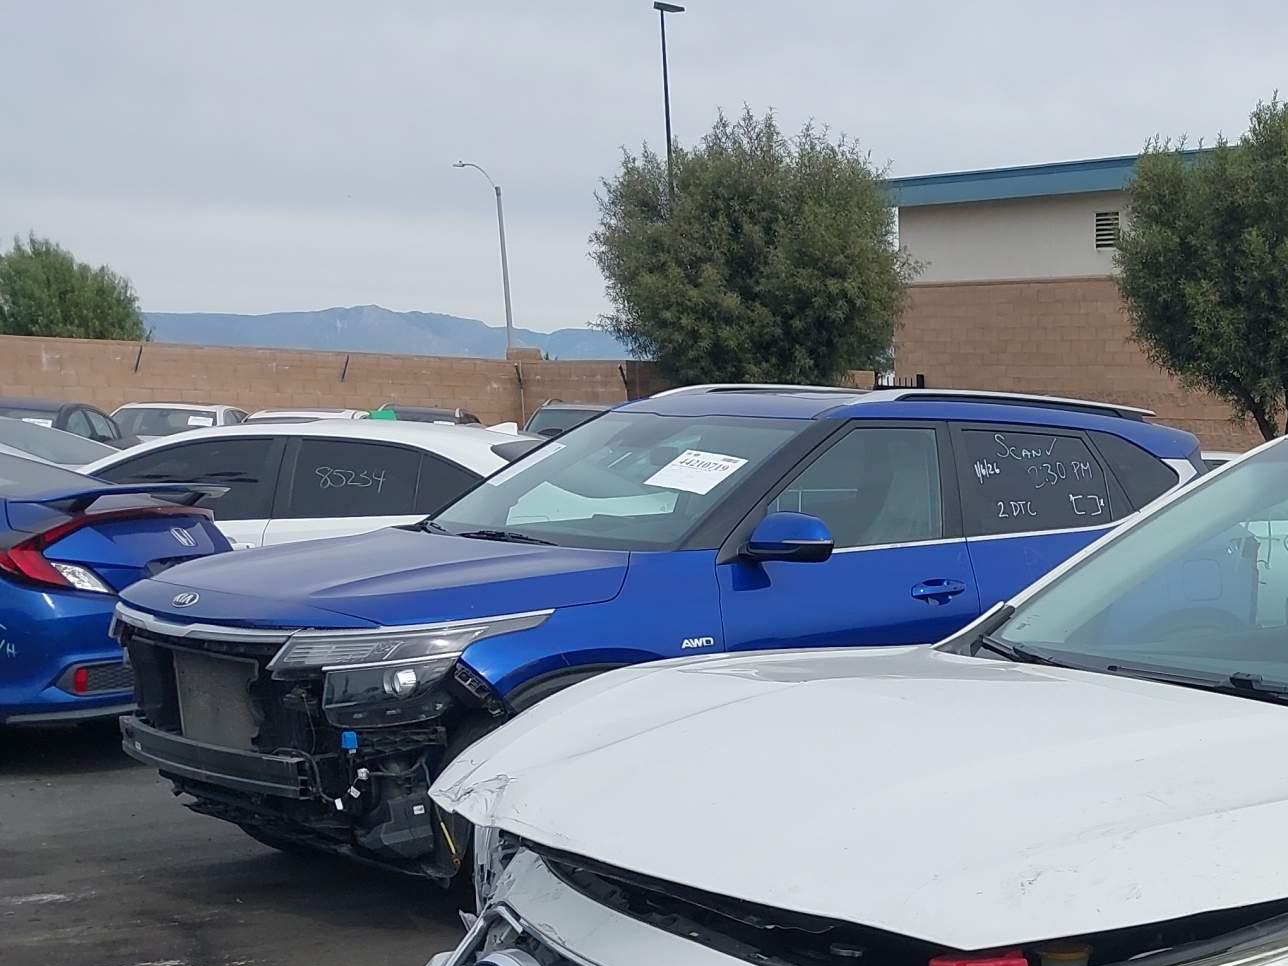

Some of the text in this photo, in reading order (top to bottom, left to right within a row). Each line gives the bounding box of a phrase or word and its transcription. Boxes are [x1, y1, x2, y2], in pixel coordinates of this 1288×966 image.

[1070, 460, 1093, 480] PM
[997, 500, 1038, 518] 2 DTC
[681, 636, 714, 649] AWD
